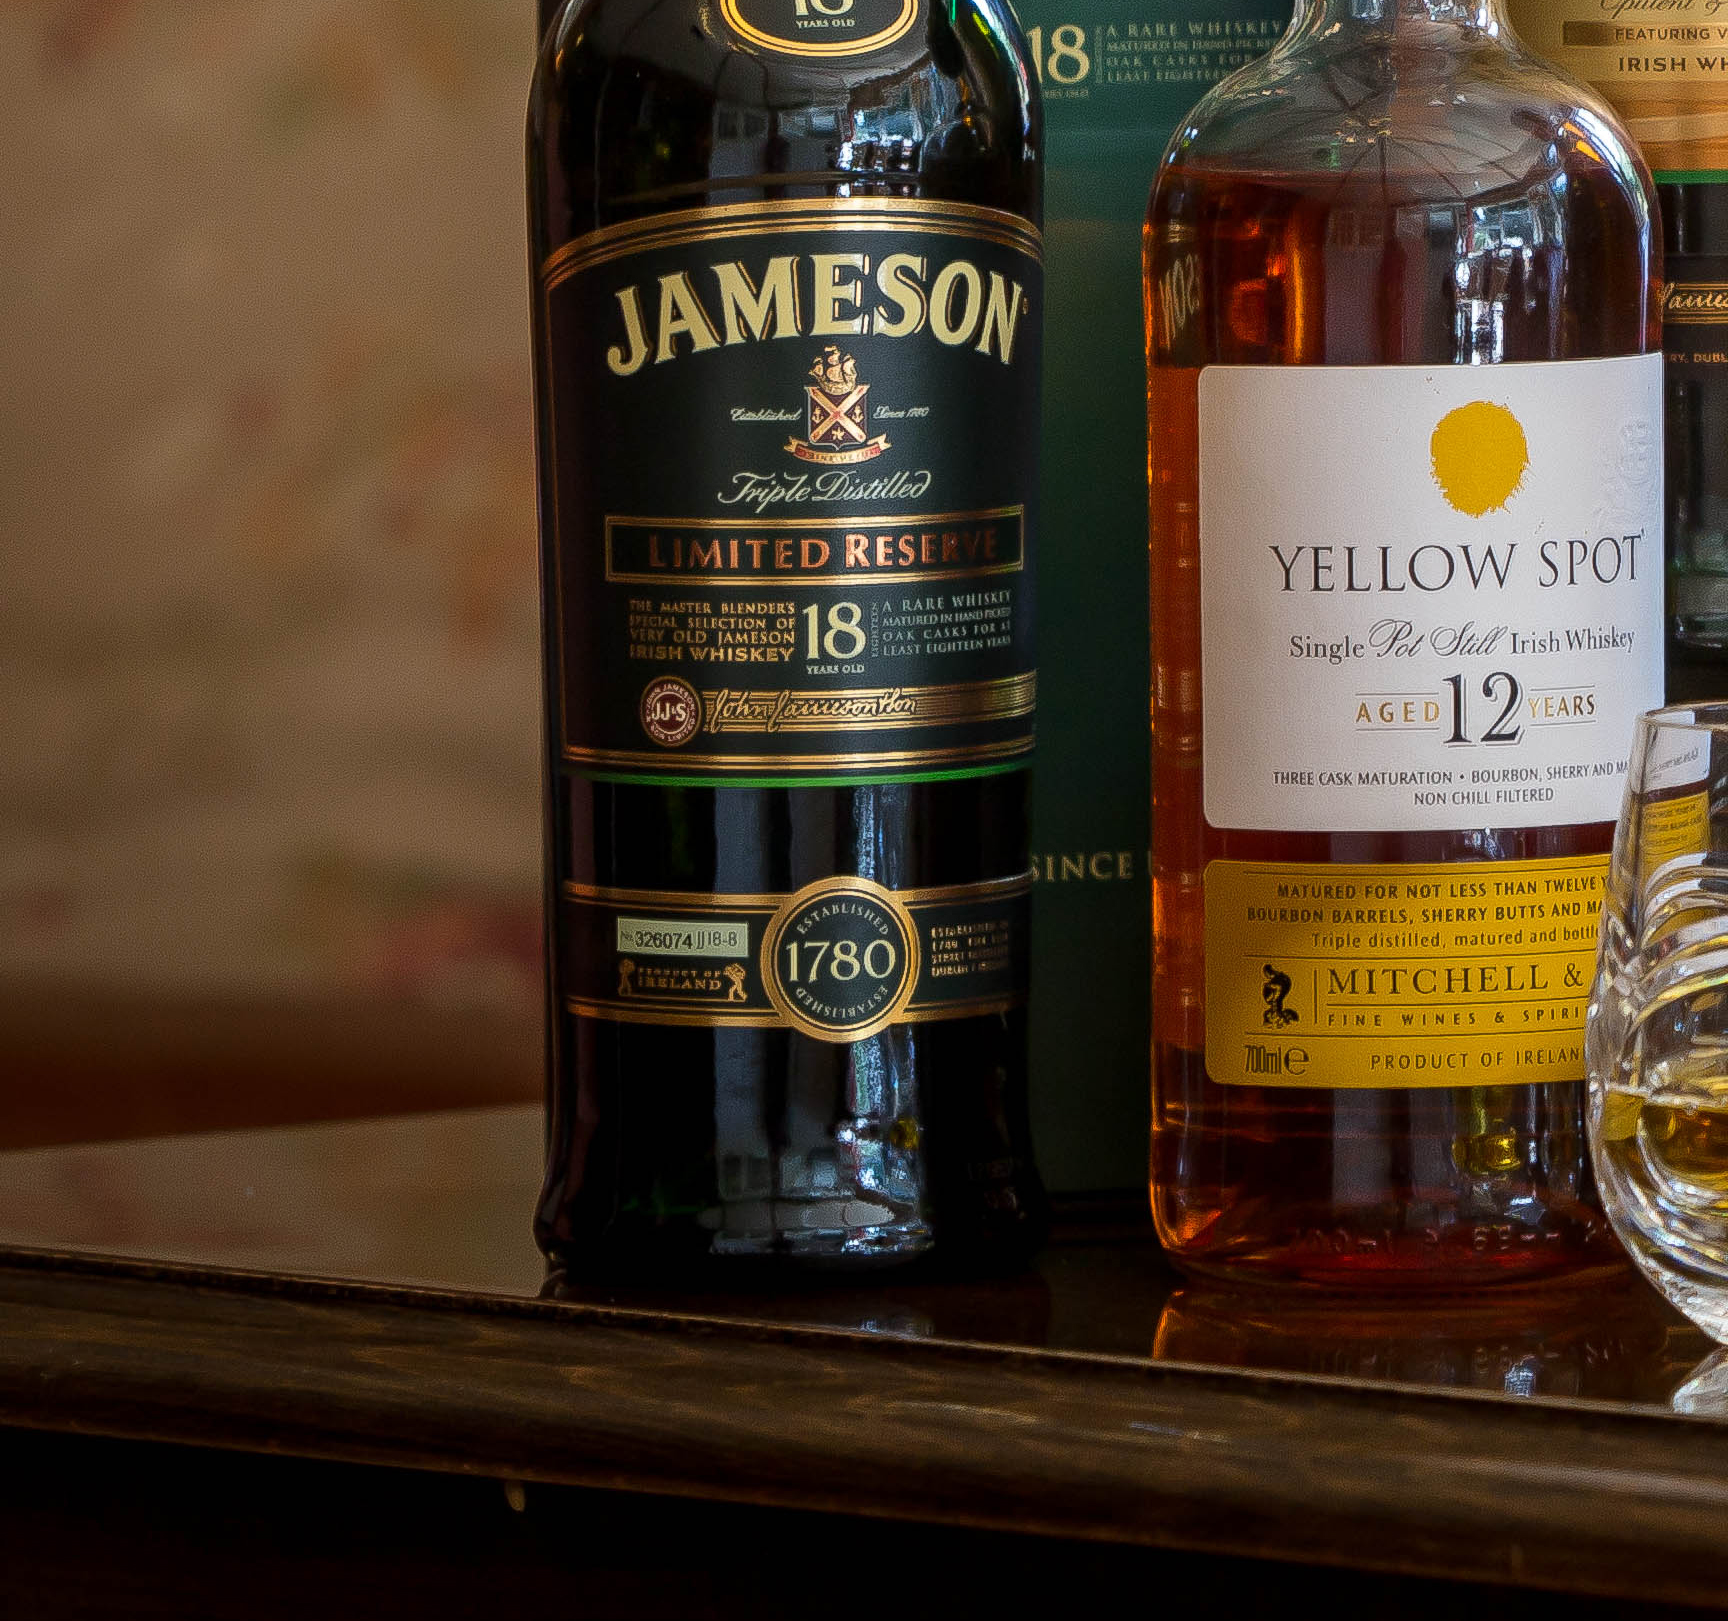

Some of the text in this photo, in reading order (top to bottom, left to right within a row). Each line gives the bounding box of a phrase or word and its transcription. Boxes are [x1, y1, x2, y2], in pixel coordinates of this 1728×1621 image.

[1616, 25, 1710, 41] FEATURING
[1028, 24, 1090, 84] 18
[1619, 55, 1686, 72] IRISH
[607, 253, 1023, 376] JAMESON
[718, 471, 931, 513] Triple Distilled
[650, 527, 998, 569] LIMITED RESERVE
[1269, 534, 1642, 592] YELLOW SPOT
[802, 602, 866, 660] 18
[1290, 619, 1634, 664] Single Pot Still Irish Whiskey
[630, 647, 794, 662] IRISH WHISKEY
[1356, 671, 1595, 745] AGED 12 YEARS
[1273, 763, 1613, 785] THREE CASK MATURATION BOURBON, SHERRY AND
[796, 902, 889, 935] ESTABLISHED
[786, 940, 895, 982] 1780
[1328, 964, 1584, 995] MITCHELL &
[795, 985, 888, 1018] ESTABLISHED
[1328, 1013, 1382, 1026] FINE
[1402, 1011, 1476, 1025] WINES
[1495, 1010, 1505, 1024] &
[1370, 1054, 1468, 1070] PRODUCT
[1481, 1050, 1503, 1066] OF
